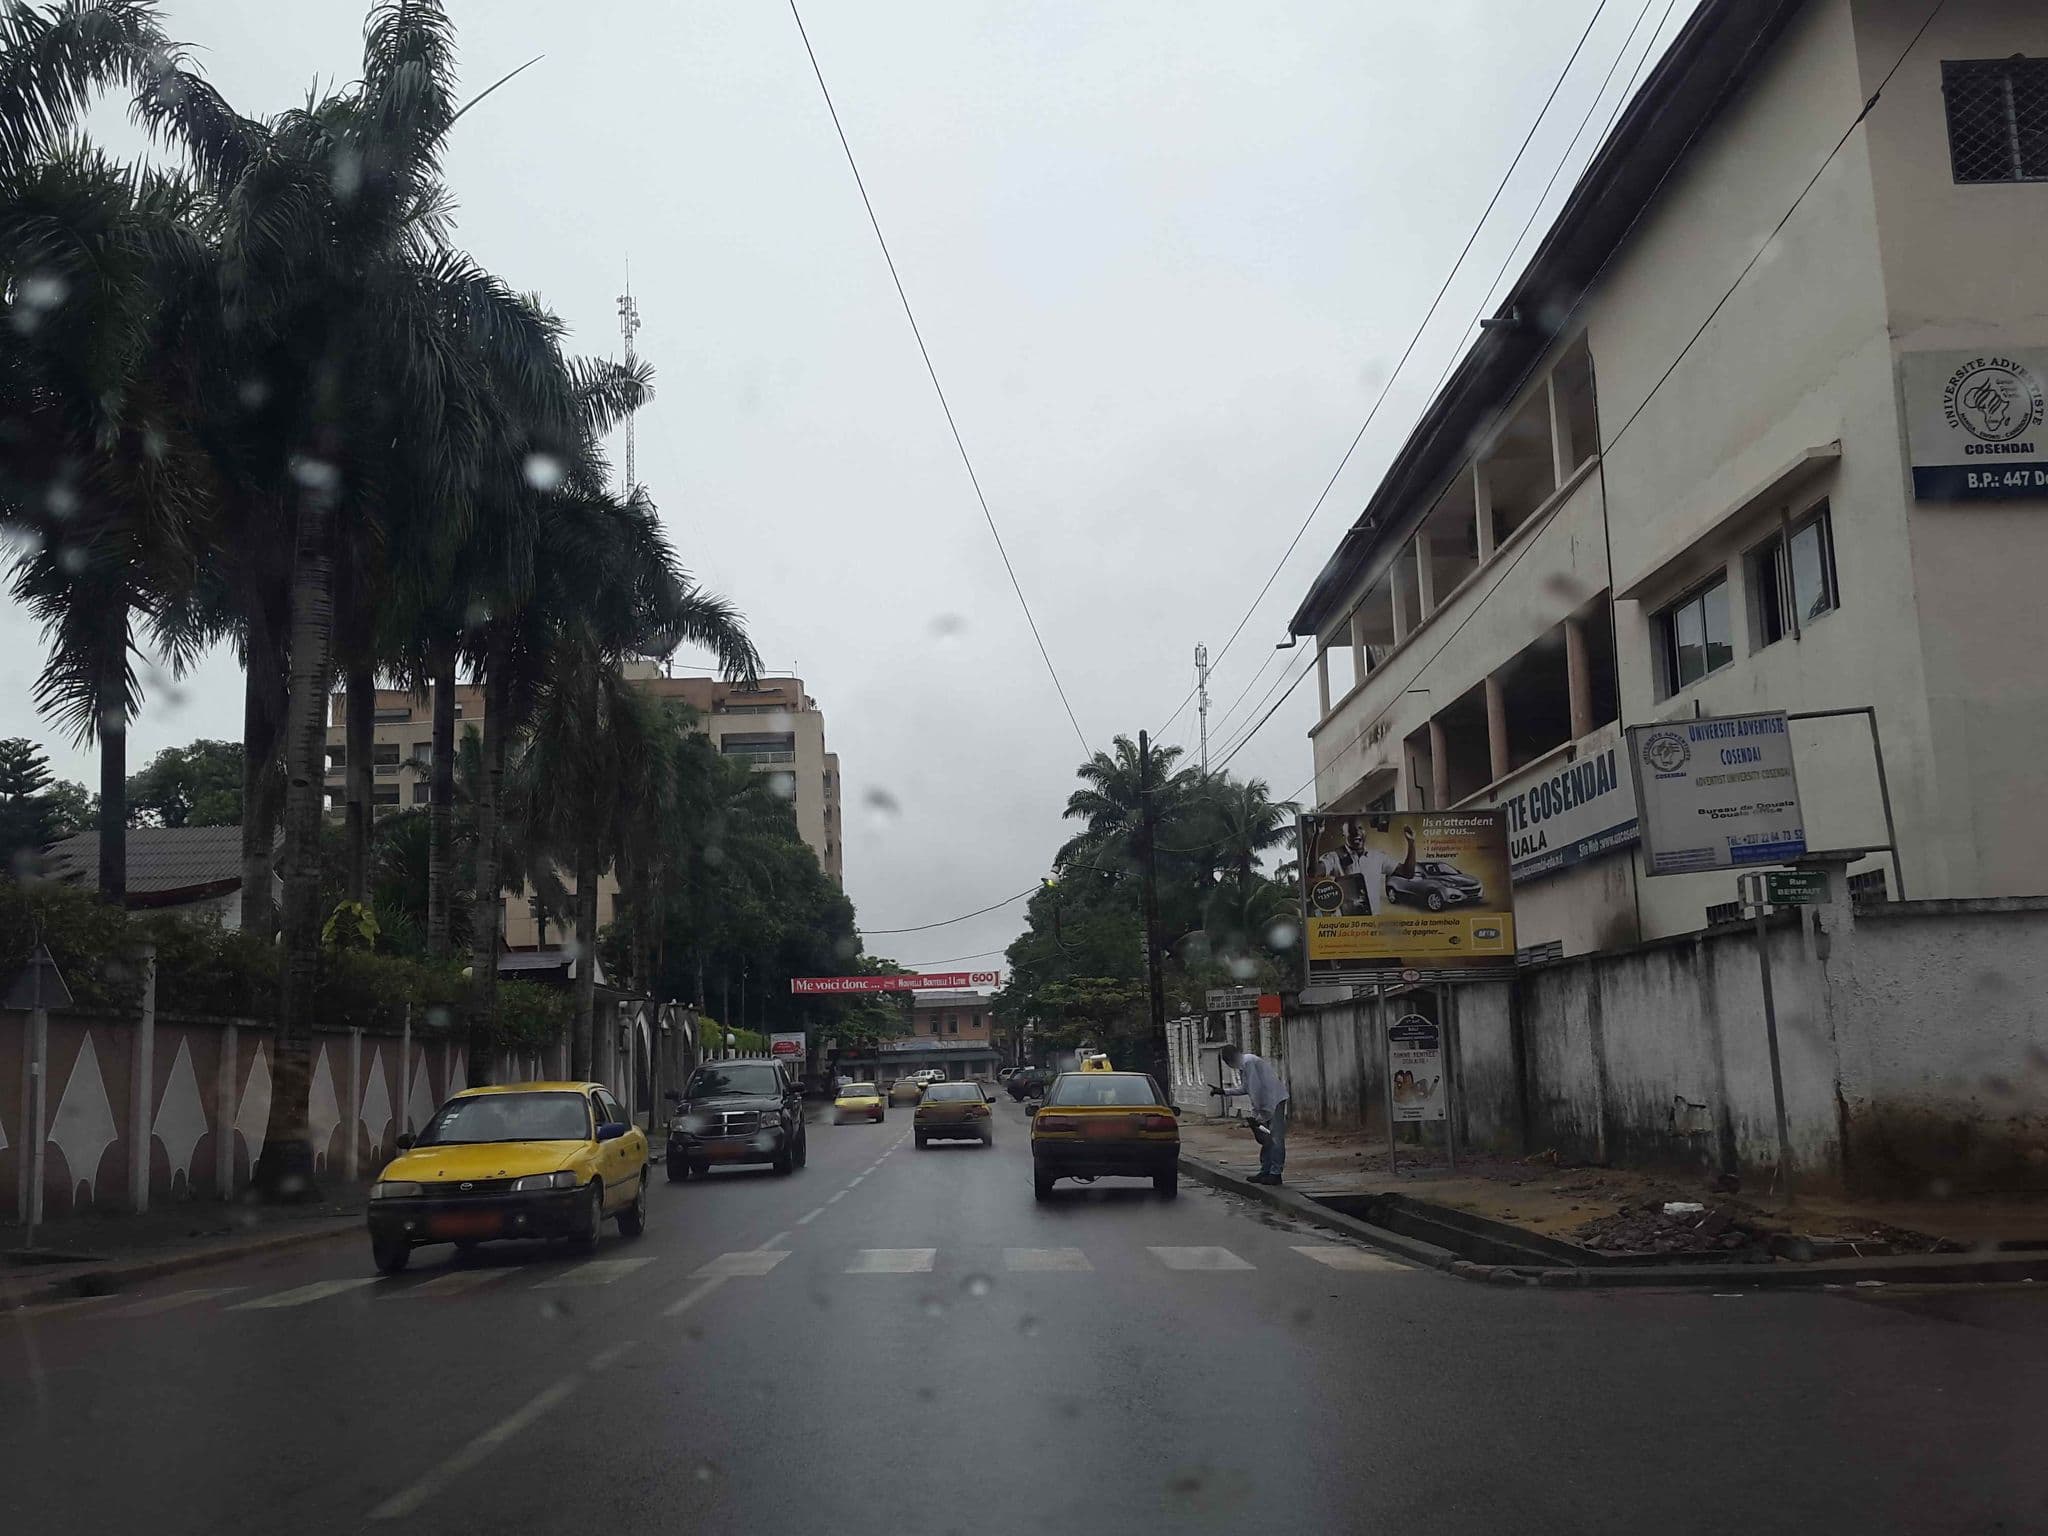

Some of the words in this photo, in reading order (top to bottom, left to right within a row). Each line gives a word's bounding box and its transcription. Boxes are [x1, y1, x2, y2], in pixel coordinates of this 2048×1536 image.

[1944, 358, 1986, 429] UNIVERSITE
[1990, 357, 2044, 426] ADVETISTE
[1965, 443, 2035, 455] COSENDAI
[1968, 473, 2000, 488] B.P.:
[2003, 472, 2030, 486] 447
[1689, 721, 1736, 742] UNIVERSITE
[1737, 717, 1785, 737] ADVENTISTE
[1720, 746, 1762, 766] COSENDAI
[1529, 749, 1617, 824] COSENDAI
[1698, 807, 1737, 815] Bureau
[1756, 800, 1795, 809] Douala
[1423, 818, 1434, 827] Ils
[1423, 829, 1441, 837] que
[1318, 921, 1350, 929] Jusqu'au
[1430, 918, 1460, 926] tombola
[1318, 930, 1337, 938] MTN
[796, 980, 813, 991] Me
[815, 979, 840, 990] voici
[842, 979, 870, 990] donc
[972, 973, 993, 982] 600
